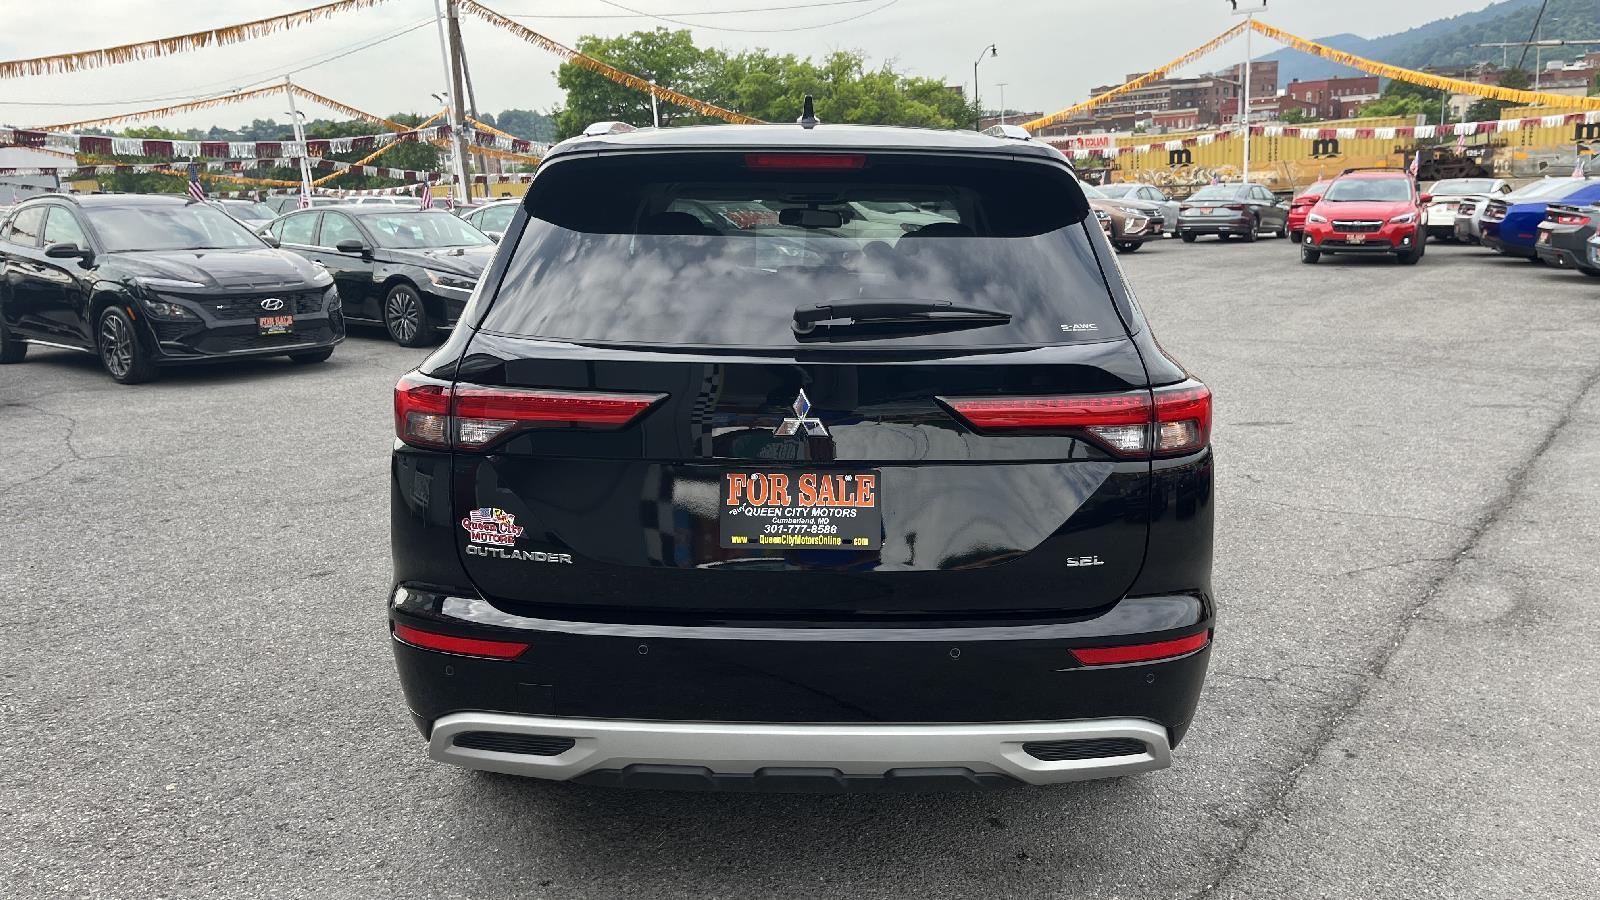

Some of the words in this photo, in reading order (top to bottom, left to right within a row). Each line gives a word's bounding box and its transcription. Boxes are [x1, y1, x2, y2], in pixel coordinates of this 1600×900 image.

[726, 473, 791, 507] FOR
[798, 474, 876, 508] SALE
[744, 507, 783, 517] QUEEN
[784, 508, 810, 517] CITY
[811, 508, 858, 518] MOTORS
[462, 518, 497, 532] Queen
[763, 525, 838, 534] 301-777-8588
[471, 532, 515, 544] MOTORS
[465, 545, 573, 564] OUTLANDER
[1066, 555, 1105, 567] SEL
